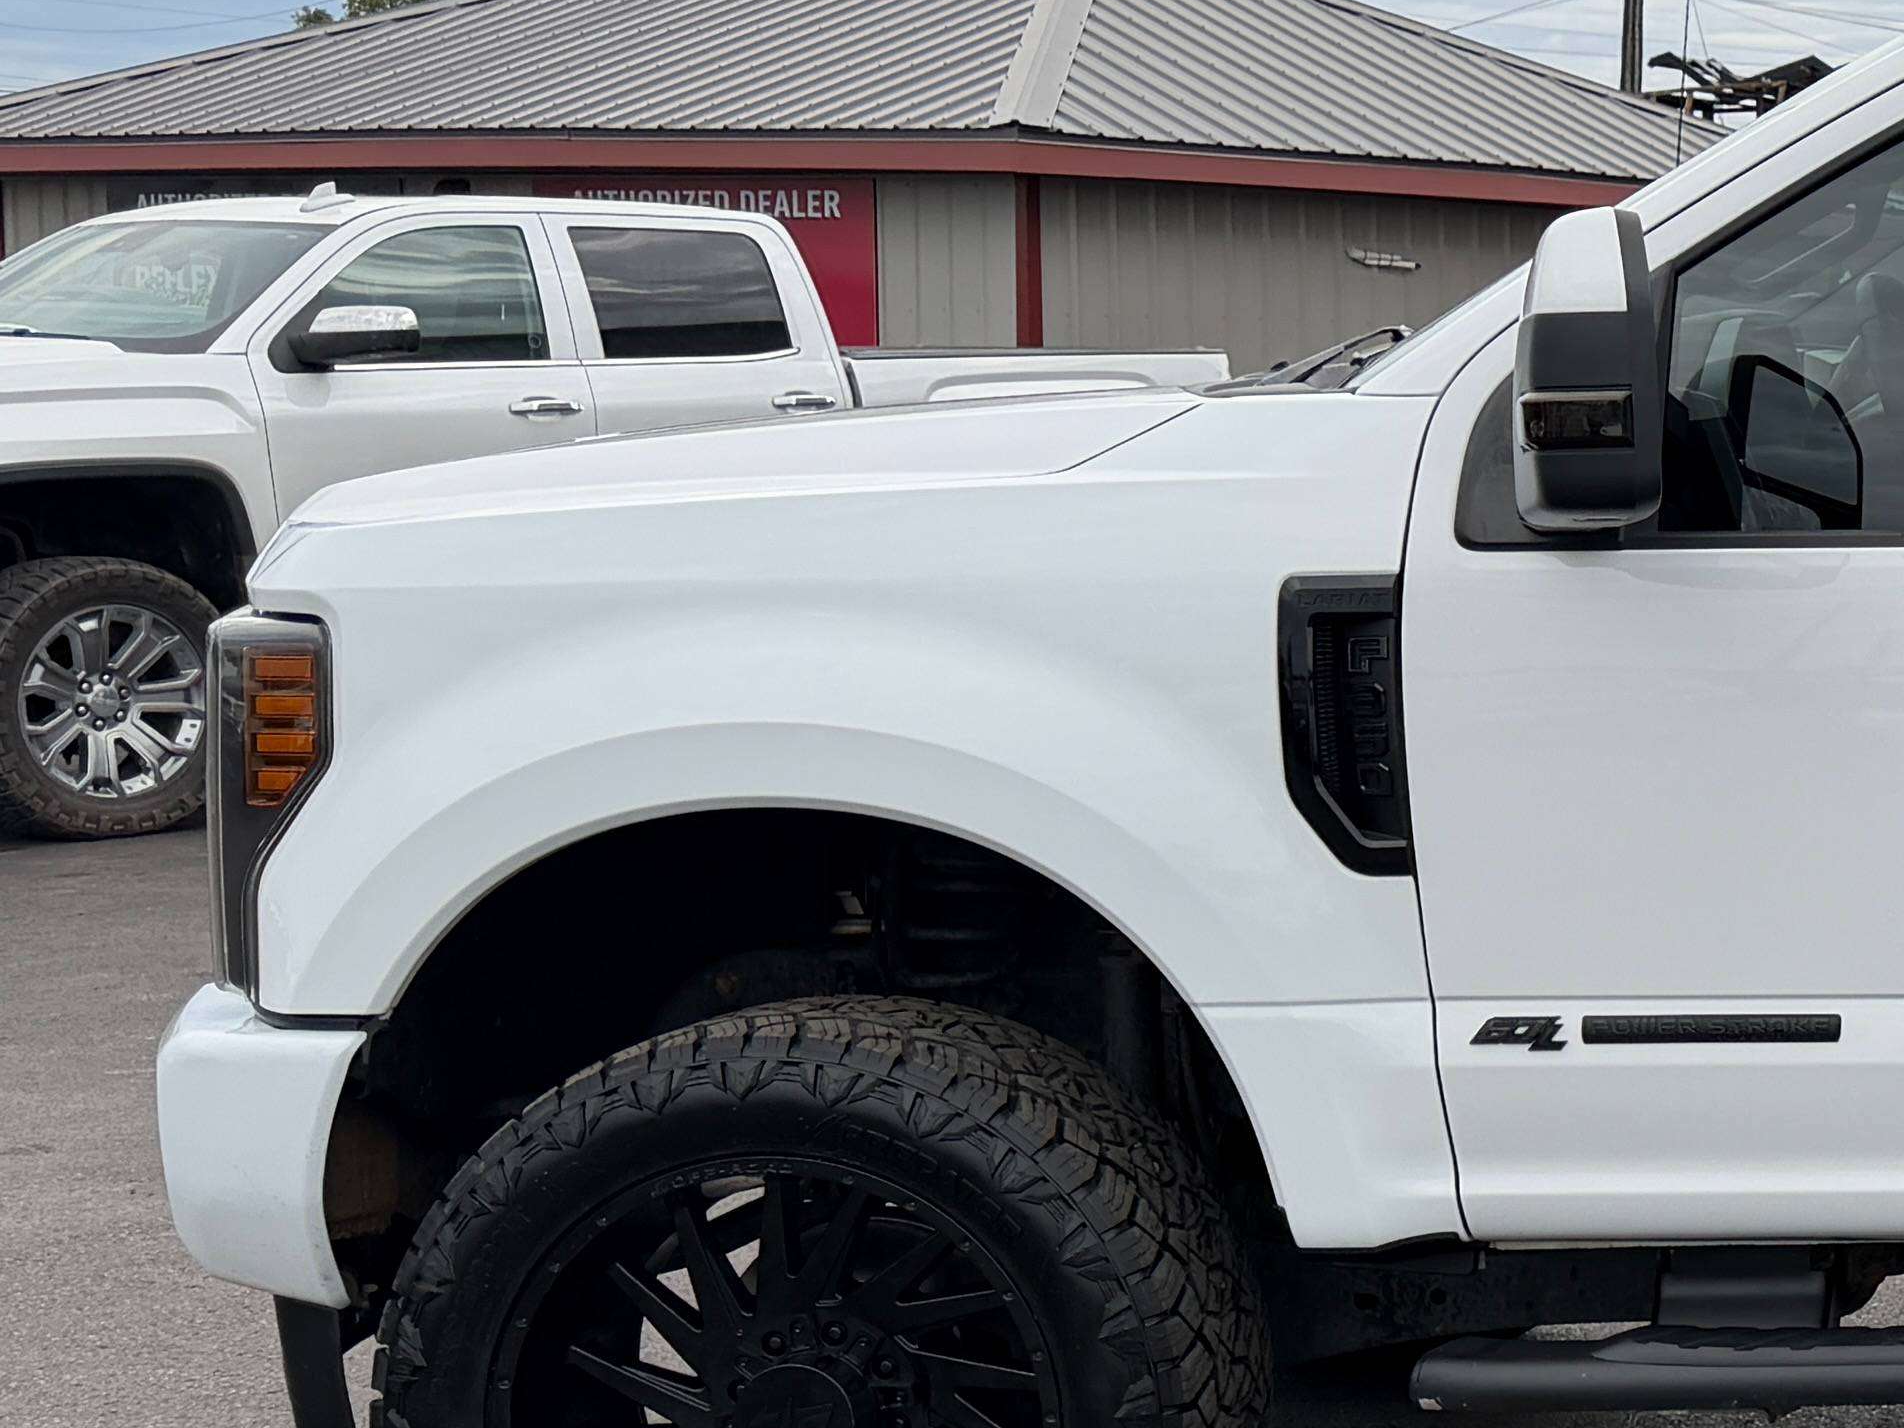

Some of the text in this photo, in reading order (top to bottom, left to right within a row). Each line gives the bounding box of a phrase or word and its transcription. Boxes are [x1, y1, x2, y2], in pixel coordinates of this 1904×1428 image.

[740, 189, 841, 218] DEALER
[1591, 1017, 1832, 1036] POWER STROKE
